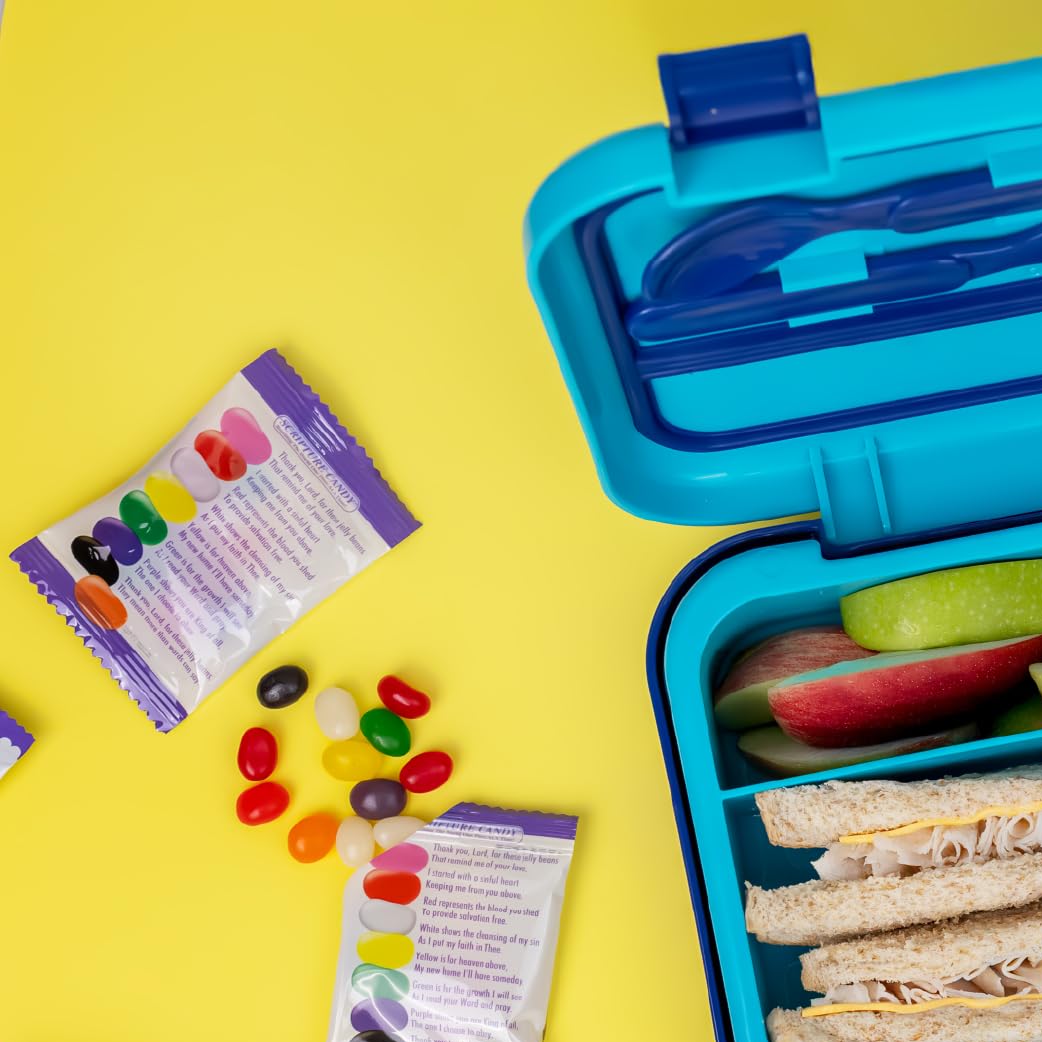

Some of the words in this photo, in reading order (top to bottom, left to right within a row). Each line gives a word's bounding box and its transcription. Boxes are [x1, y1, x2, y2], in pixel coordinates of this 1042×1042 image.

[441, 925, 461, 937] shows
[462, 927, 475, 938] the
[475, 930, 508, 944] cleansing
[509, 933, 517, 943] of
[518, 937, 529, 947] my
